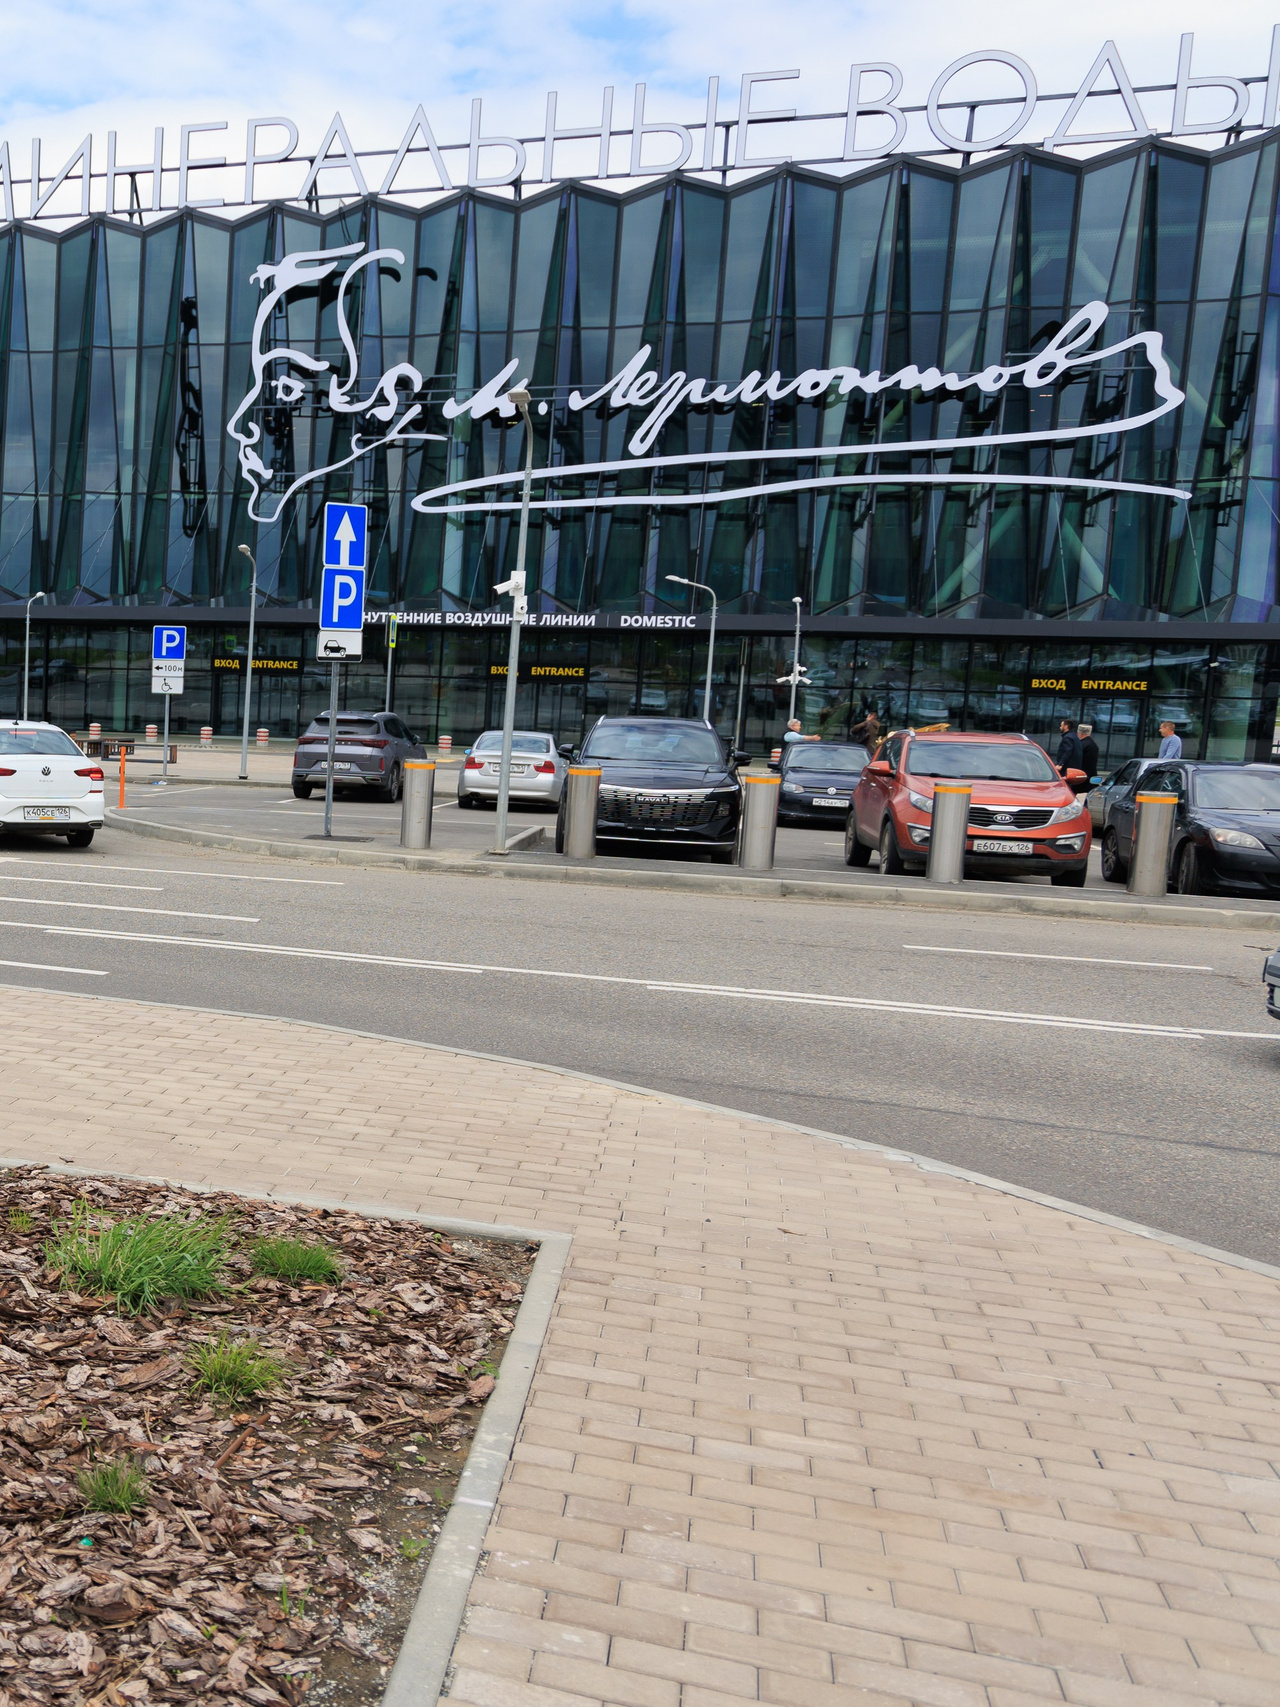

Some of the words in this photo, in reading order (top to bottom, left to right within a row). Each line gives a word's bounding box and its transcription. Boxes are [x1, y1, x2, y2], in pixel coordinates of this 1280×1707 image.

[842, 23, 1280, 160] ВОДЫ
[332, 574, 357, 623] P
[539, 614, 596, 627] ЛИНИИ
[620, 615, 697, 628] DOMESTIC
[161, 629, 181, 656] P
[214, 659, 240, 669] ВХОД
[250, 660, 298, 669] ENTRANCE
[531, 666, 585, 677] ENTRANCE
[1031, 678, 1066, 691] ВХОД
[1081, 680, 1148, 691] ENTRANCE
[1016, 843, 1030, 851] 126
